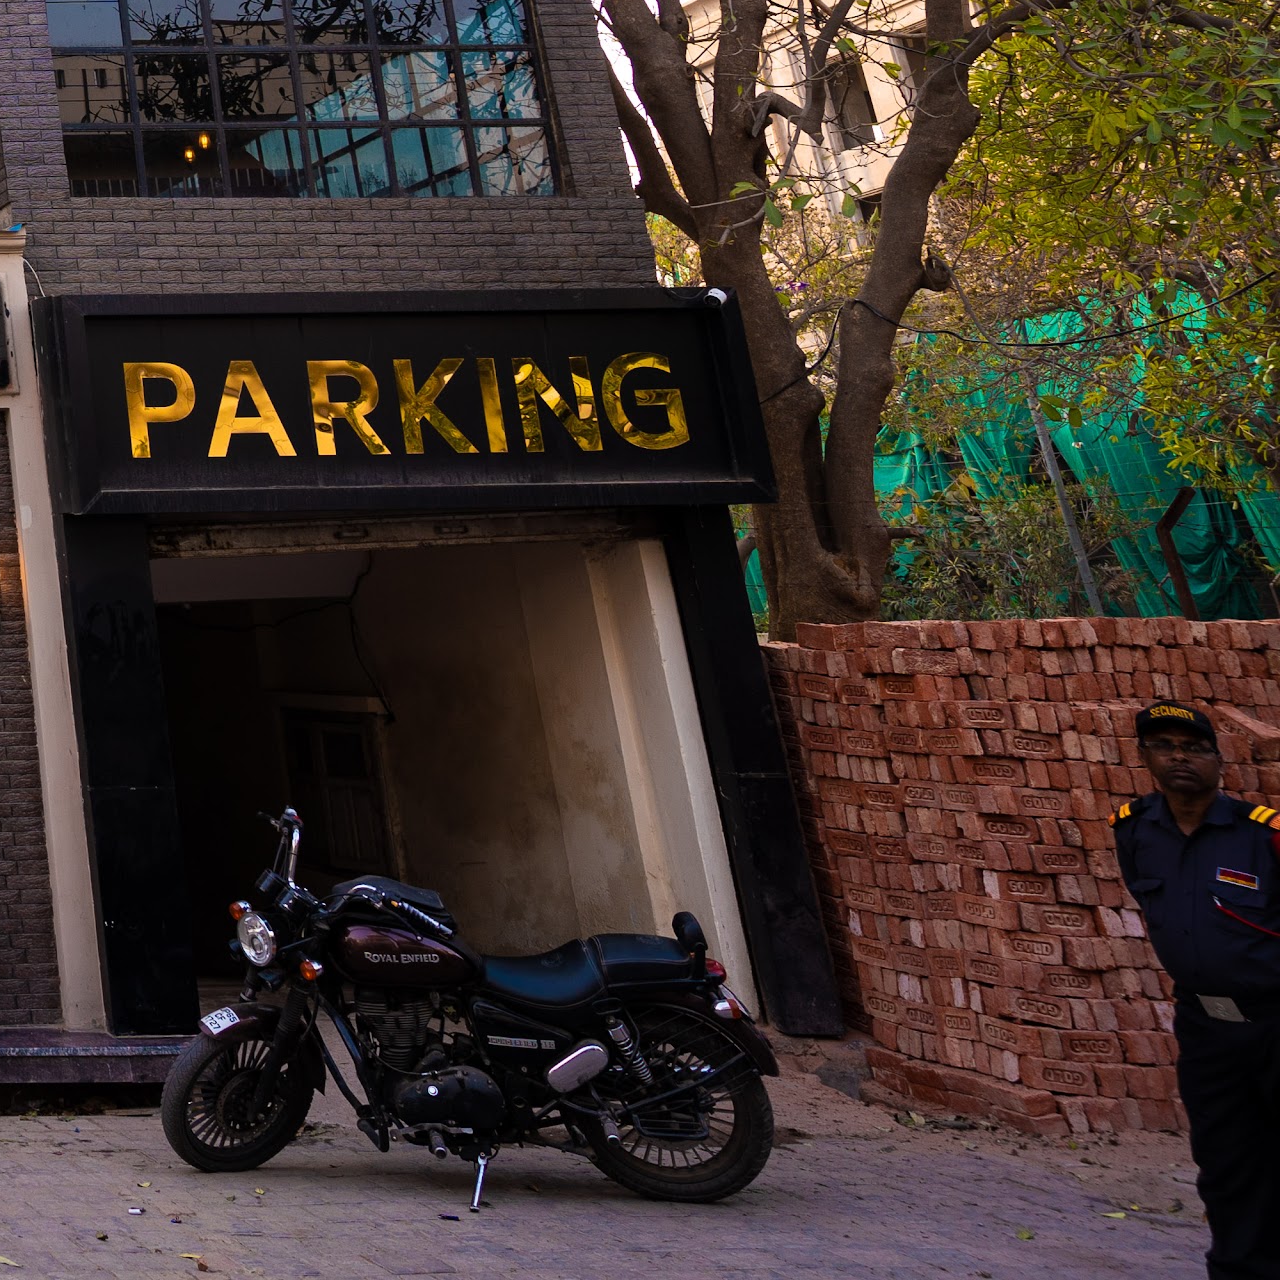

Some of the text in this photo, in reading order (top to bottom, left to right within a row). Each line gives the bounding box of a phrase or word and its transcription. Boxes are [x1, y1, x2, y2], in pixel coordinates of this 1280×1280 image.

[123, 352, 691, 458] PARKING
[969, 708, 1001, 720] GOLD
[1149, 705, 1195, 720] SECURITY
[1014, 738, 1049, 752] GOLD
[907, 787, 934, 800] GOLD
[1023, 796, 1059, 810] GOLD
[987, 822, 1025, 834] GOLD
[1043, 854, 1076, 866] GOLD
[1008, 880, 1043, 893] GOLD
[965, 904, 995, 919] GOLD
[1045, 913, 1082, 926] GOLD
[1014, 939, 1053, 955] GOLD
[364, 951, 439, 963] ROYAL ENFIELD
[1051, 974, 1089, 988] GOLD
[1019, 998, 1059, 1016] GOLD
[945, 1016, 971, 1030] GOLD
[1074, 1040, 1110, 1053] GOLD
[1045, 1070, 1083, 1084] GOLD
